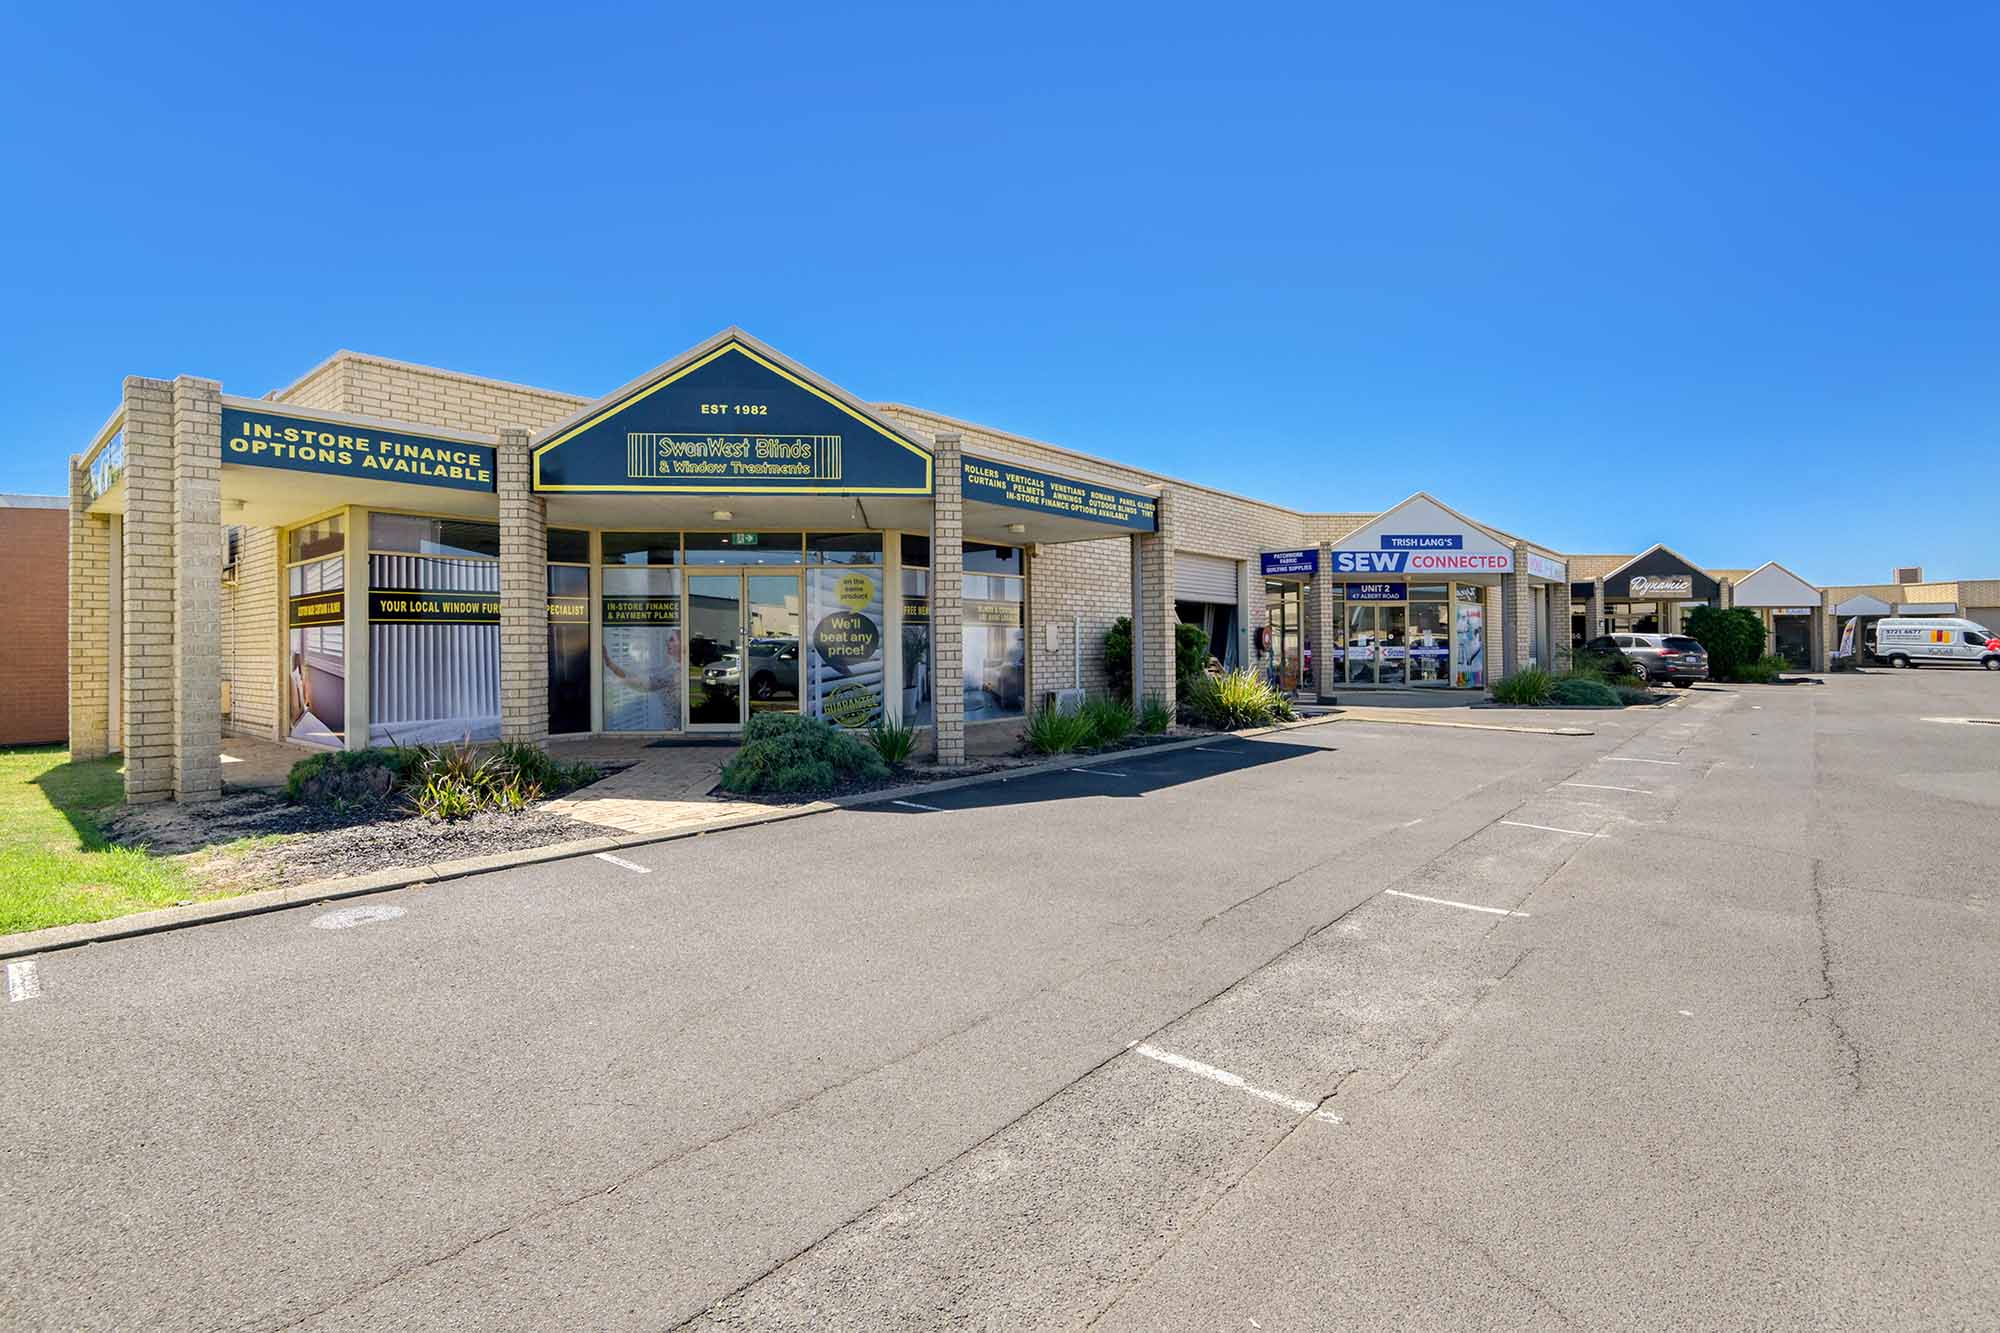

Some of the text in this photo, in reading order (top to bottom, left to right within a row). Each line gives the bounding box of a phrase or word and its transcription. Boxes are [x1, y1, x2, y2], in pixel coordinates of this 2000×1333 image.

[701, 404, 768, 415] EST 1982
[243, 422, 481, 467] IN-STORE FINANCE
[659, 437, 811, 459] SwanWest Blinds
[230, 438, 490, 482] OPTIONS AVAILABLE
[659, 460, 811, 475] & Window Treatments
[964, 464, 999, 478] ROLLERS
[1006, 473, 1045, 488] VERTICALS
[1050, 483, 1085, 496] VENETIANS
[968, 475, 1007, 489] CURTAINS
[1013, 484, 1045, 497] PELMETS
[1053, 491, 1082, 504] AWNINGS
[1089, 499, 1117, 511] OUTDOOR
[1006, 491, 1128, 520] IN-STORE FINANCE OPTIONS AVAILABLE
[1391, 538, 1453, 547] TRISH LANG'S
[1338, 552, 1508, 571] SEW CONNECTED
[1361, 584, 1390, 593] UNIT 2
[1630, 576, 1689, 596] Dynamic
[380, 600, 407, 613] YOUR
[410, 601, 440, 613] LOCAL
[442, 602, 479, 614] WINDOW
[546, 604, 584, 616] PECIALIST
[607, 602, 680, 611] IN-STORE FINANCE
[616, 611, 652, 619] PAYMENT
[654, 611, 680, 619] PLANS
[831, 618, 861, 629] We'll
[820, 631, 872, 645] beat any
[828, 644, 864, 658] price!
